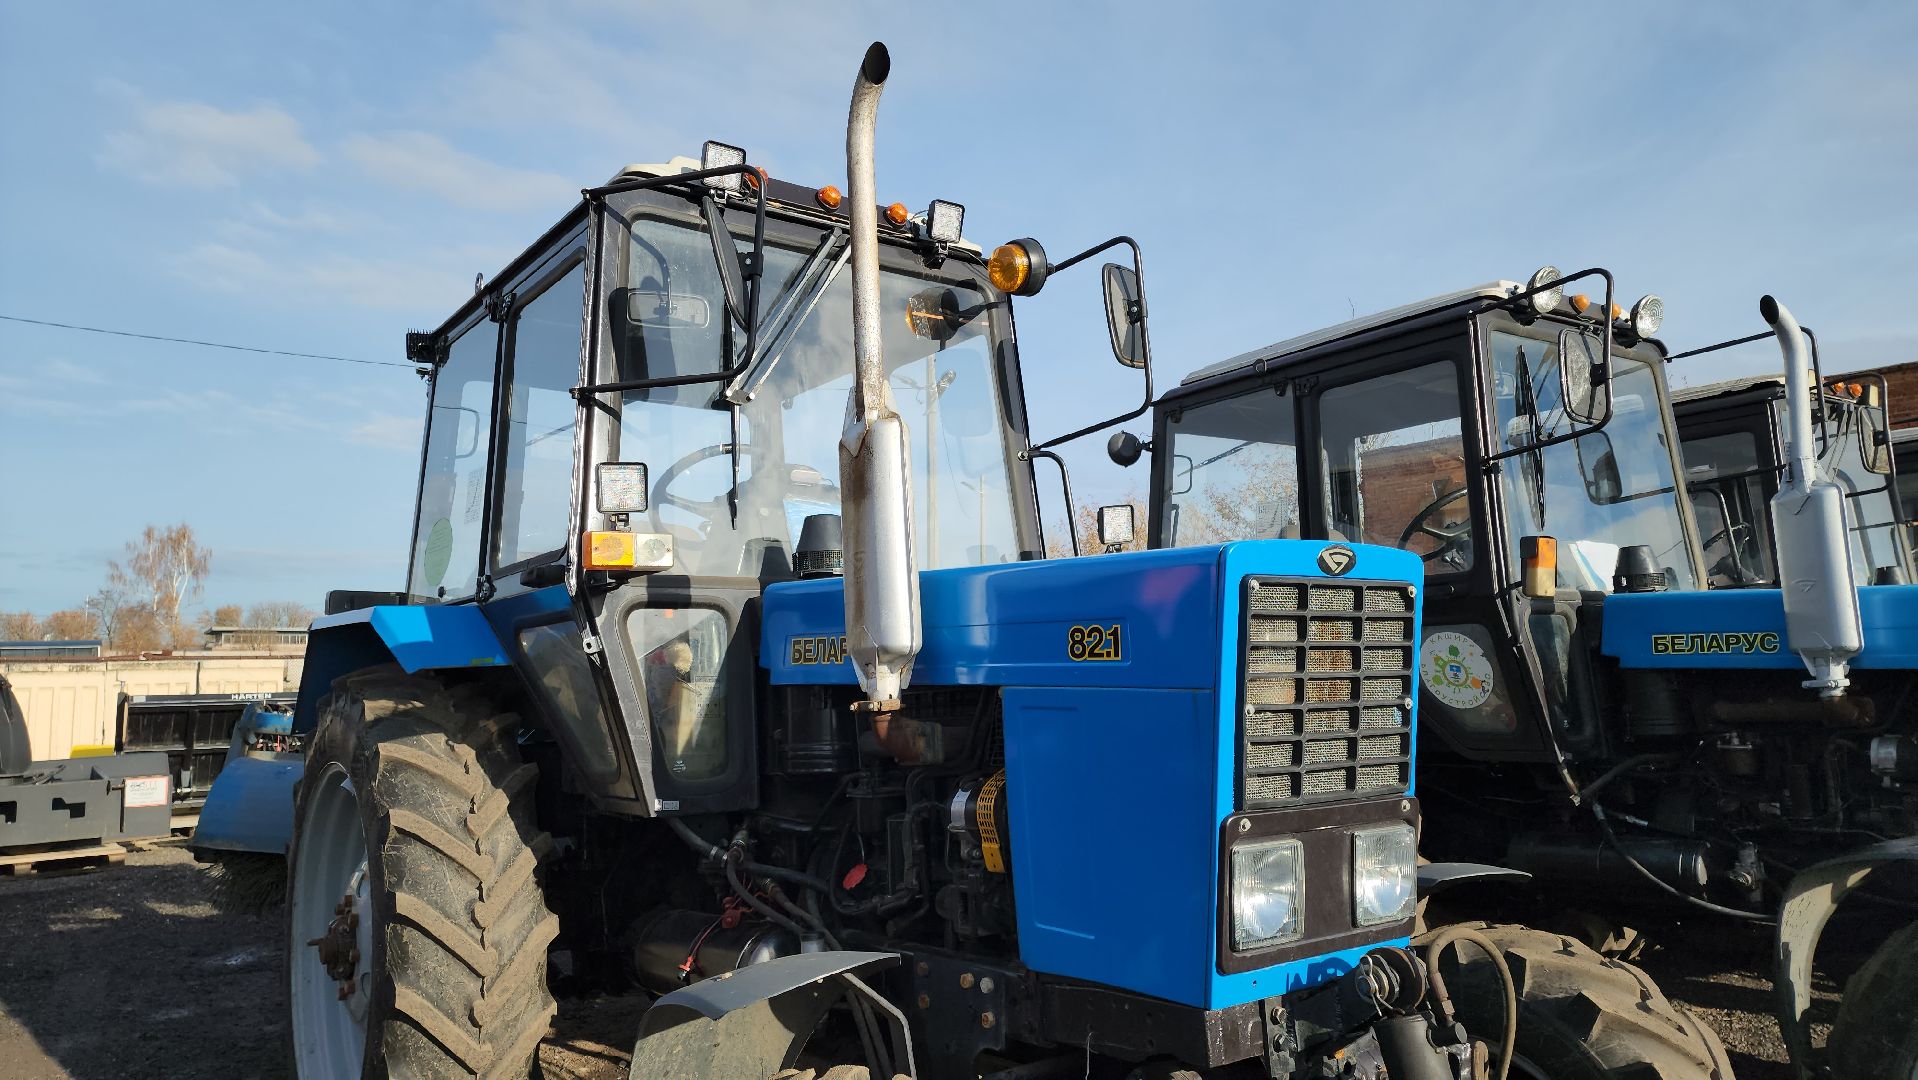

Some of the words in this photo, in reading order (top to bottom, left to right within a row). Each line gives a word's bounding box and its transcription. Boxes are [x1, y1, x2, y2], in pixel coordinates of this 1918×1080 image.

[792, 636, 848, 664] БЕЛАР
[1069, 624, 1121, 661] 82.1
[1652, 632, 1779, 654] БЕЛАРУС
